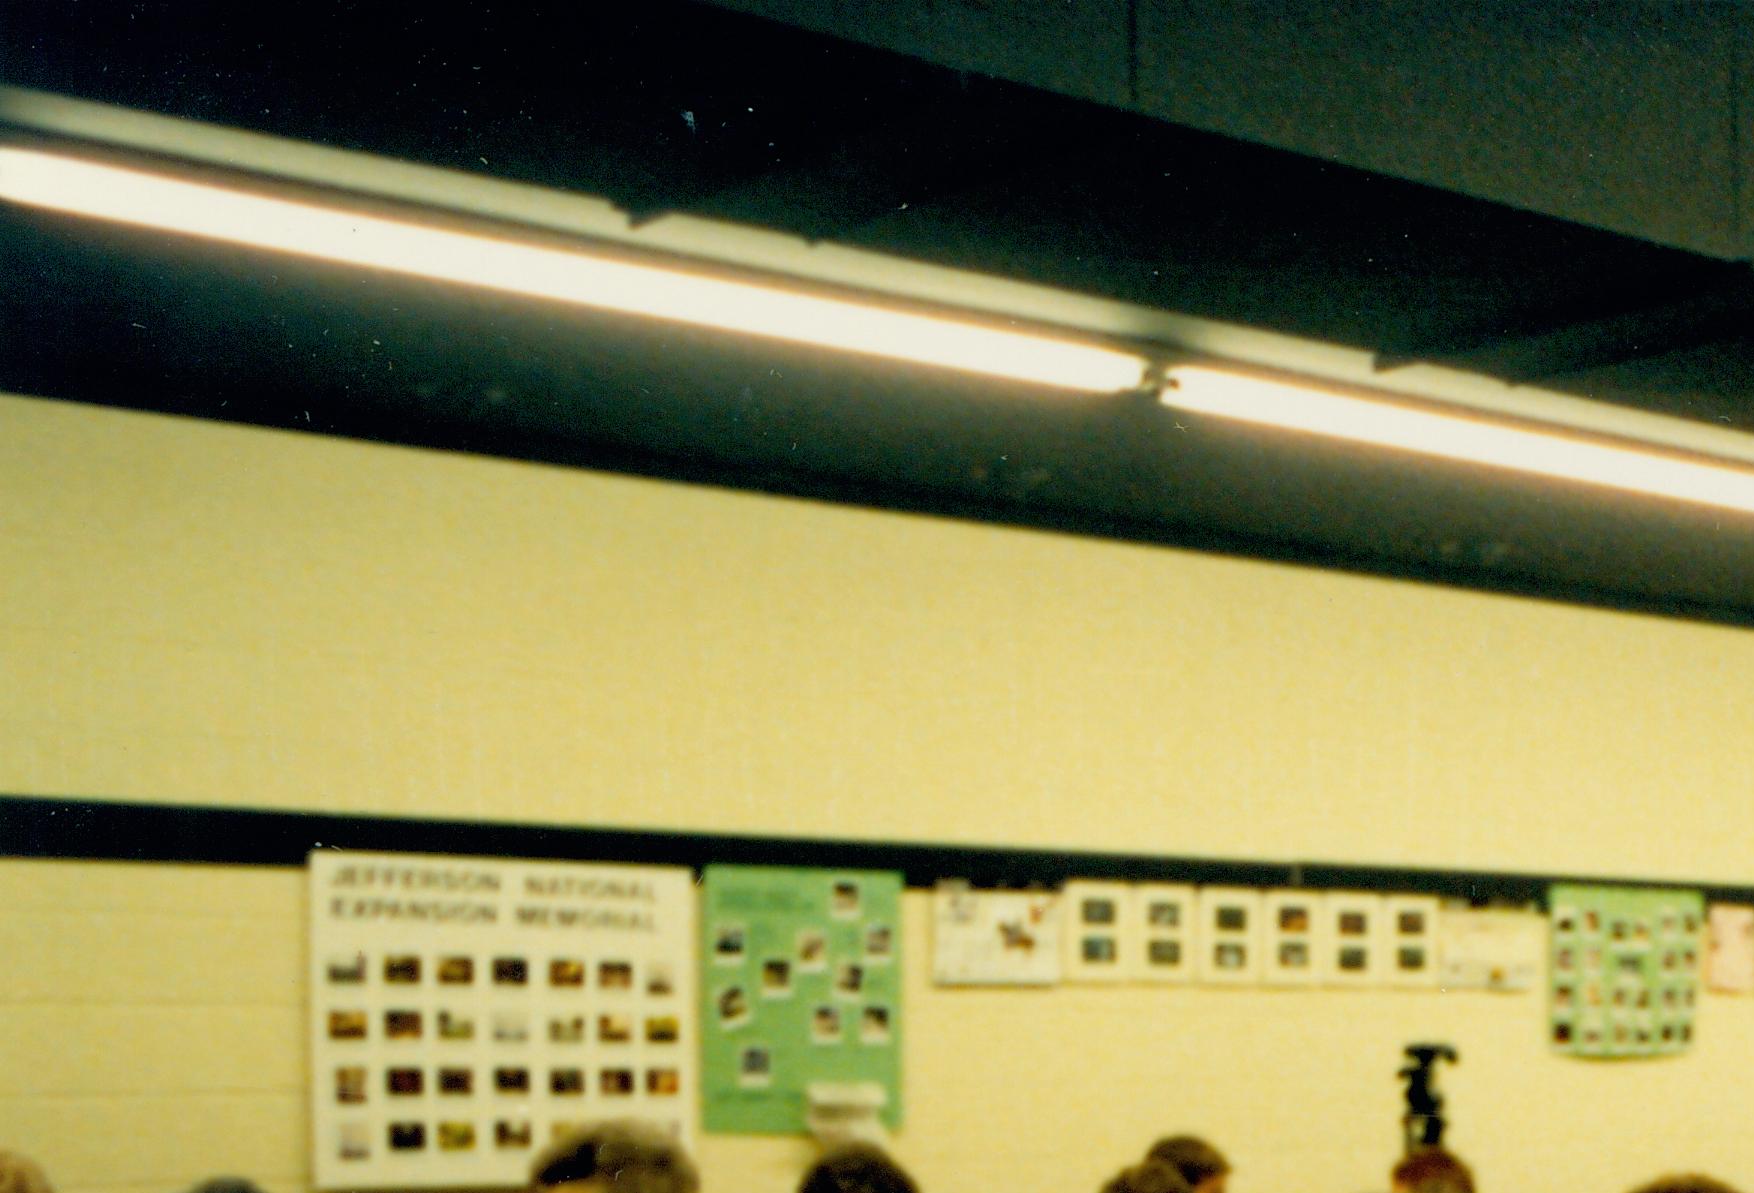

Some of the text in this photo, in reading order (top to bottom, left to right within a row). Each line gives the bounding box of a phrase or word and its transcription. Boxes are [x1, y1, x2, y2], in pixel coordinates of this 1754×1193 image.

[332, 865, 656, 902] JEFFERSON NATIONAL
[329, 896, 656, 933] EXPANSION MEMORIAL
